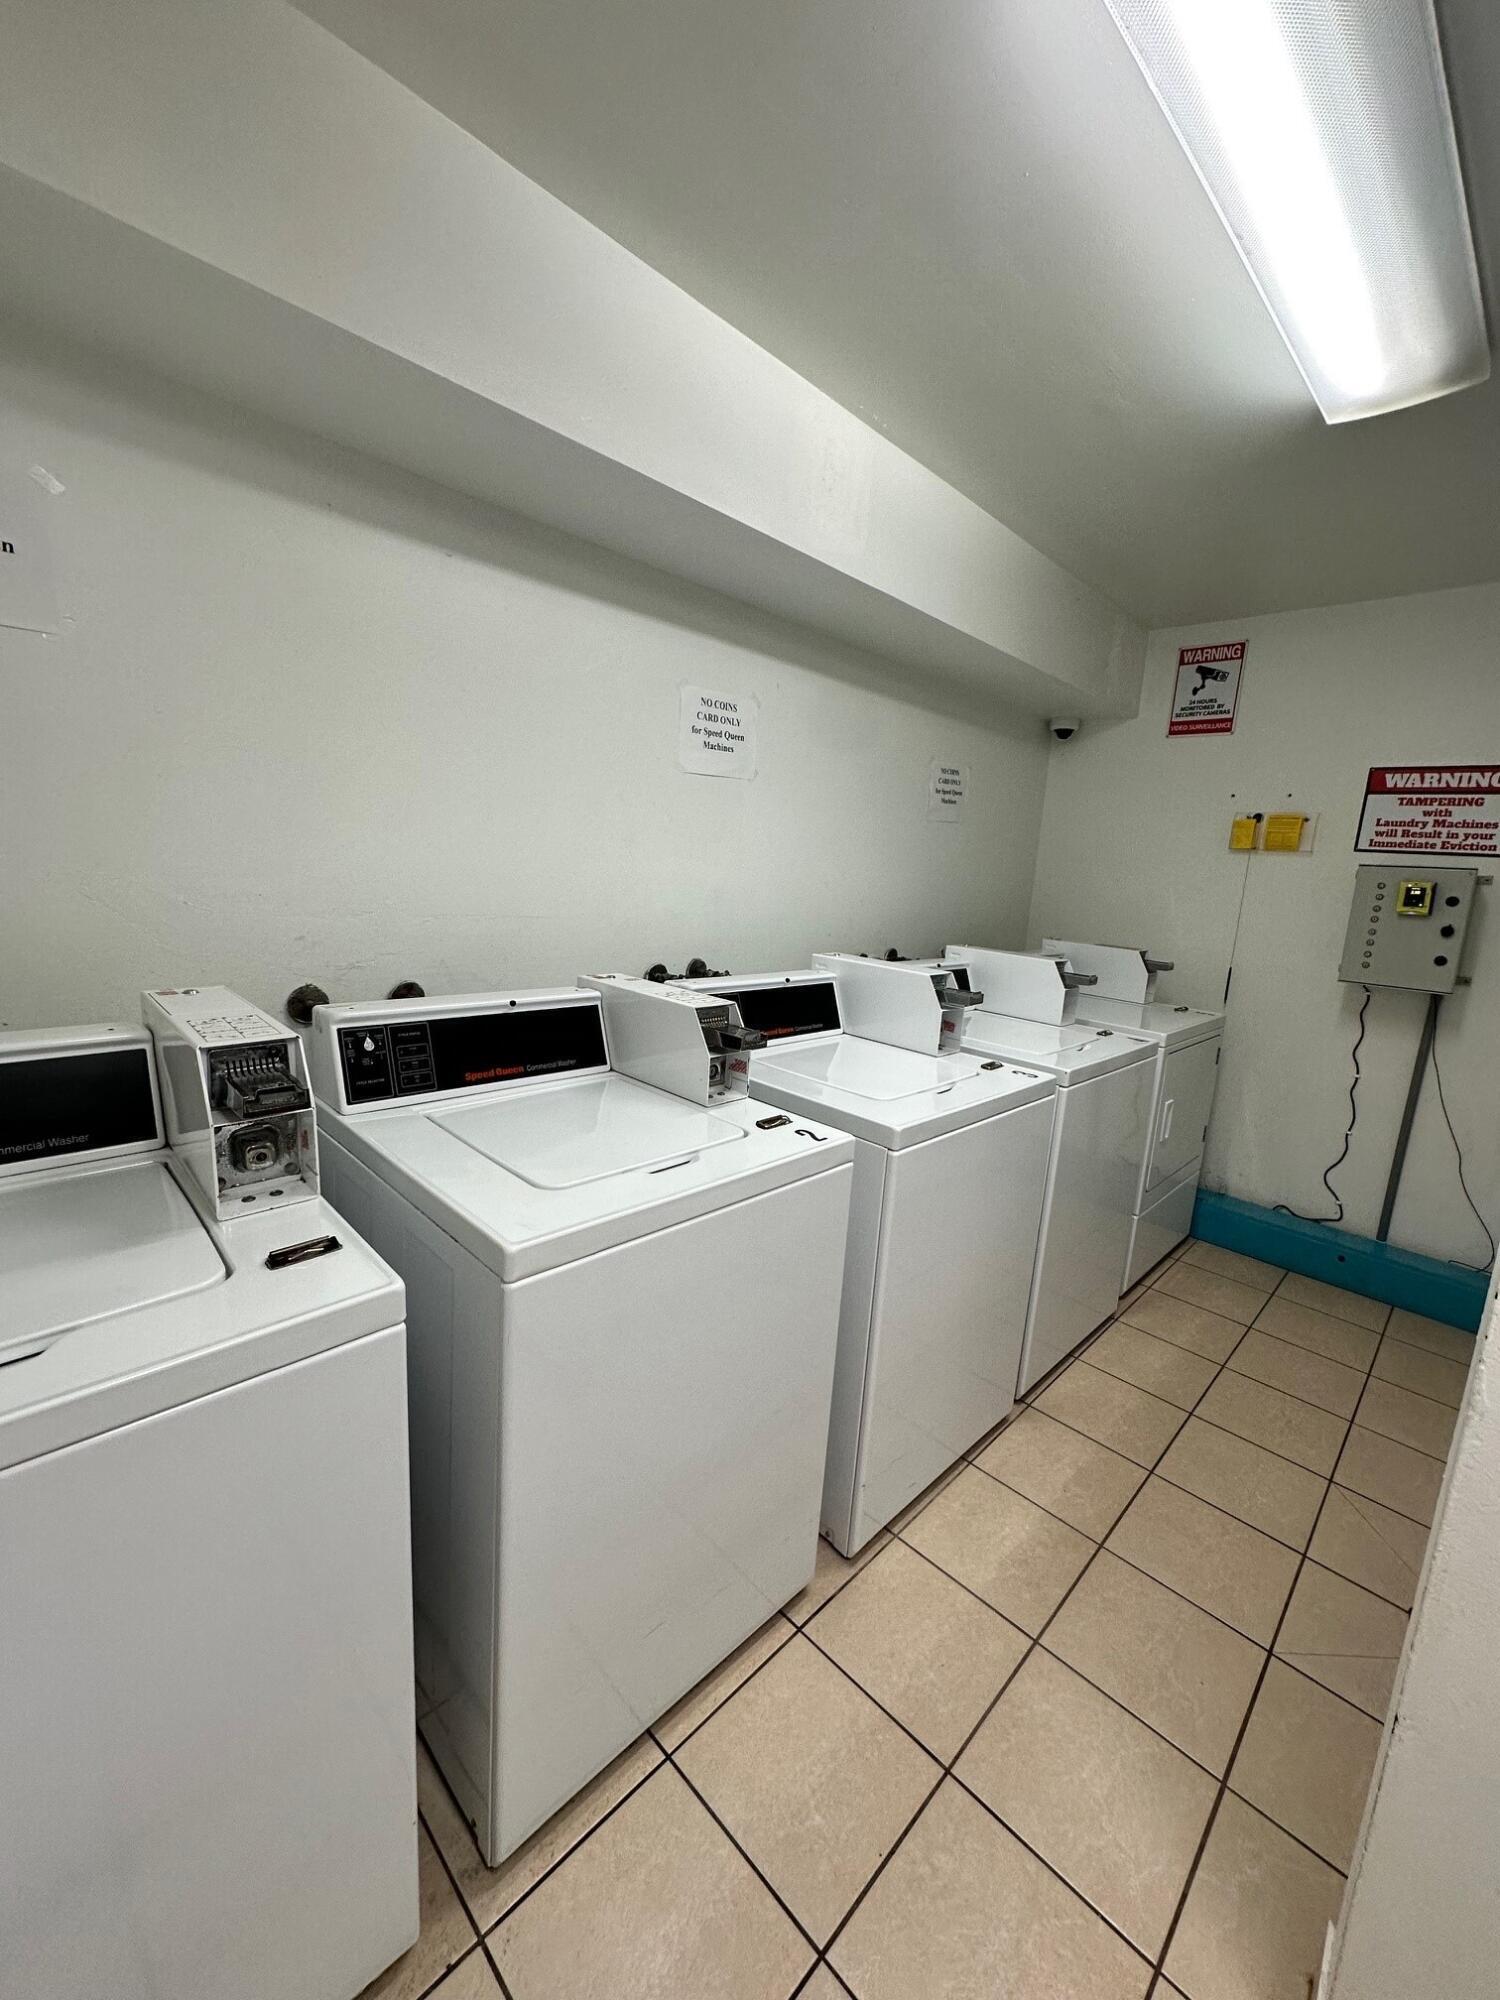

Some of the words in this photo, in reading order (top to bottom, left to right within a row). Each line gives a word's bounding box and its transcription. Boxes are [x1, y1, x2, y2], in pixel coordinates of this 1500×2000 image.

[1183, 644, 1242, 664] WARNING
[700, 697, 713, 708] NO
[714, 700, 738, 712] COINS
[696, 711, 719, 723] CARD
[720, 716, 742, 727] ONLY
[1188, 721, 1232, 730] SURVEILLANCE
[691, 724, 702, 734] for
[704, 726, 722, 738] Speed
[724, 730, 744, 742] Queen
[703, 740, 735, 752] Machines
[1398, 797, 1486, 807] TAMPERING
[1422, 808, 1452, 818] with
[1375, 818, 1429, 830] Laundry
[1432, 818, 1500, 830] Machines
[1374, 829, 1398, 838] will
[1400, 830, 1442, 839] Result
[1446, 830, 1459, 840] in
[1462, 832, 1496, 842] your
[1368, 838, 1437, 850] Immediate
[1440, 840, 1498, 852] Eviction
[464, 1068, 495, 1082] Speed
[496, 1065, 525, 1077] Queen
[48, 1134, 90, 1148] Washer
[794, 1129, 828, 1142] 2
